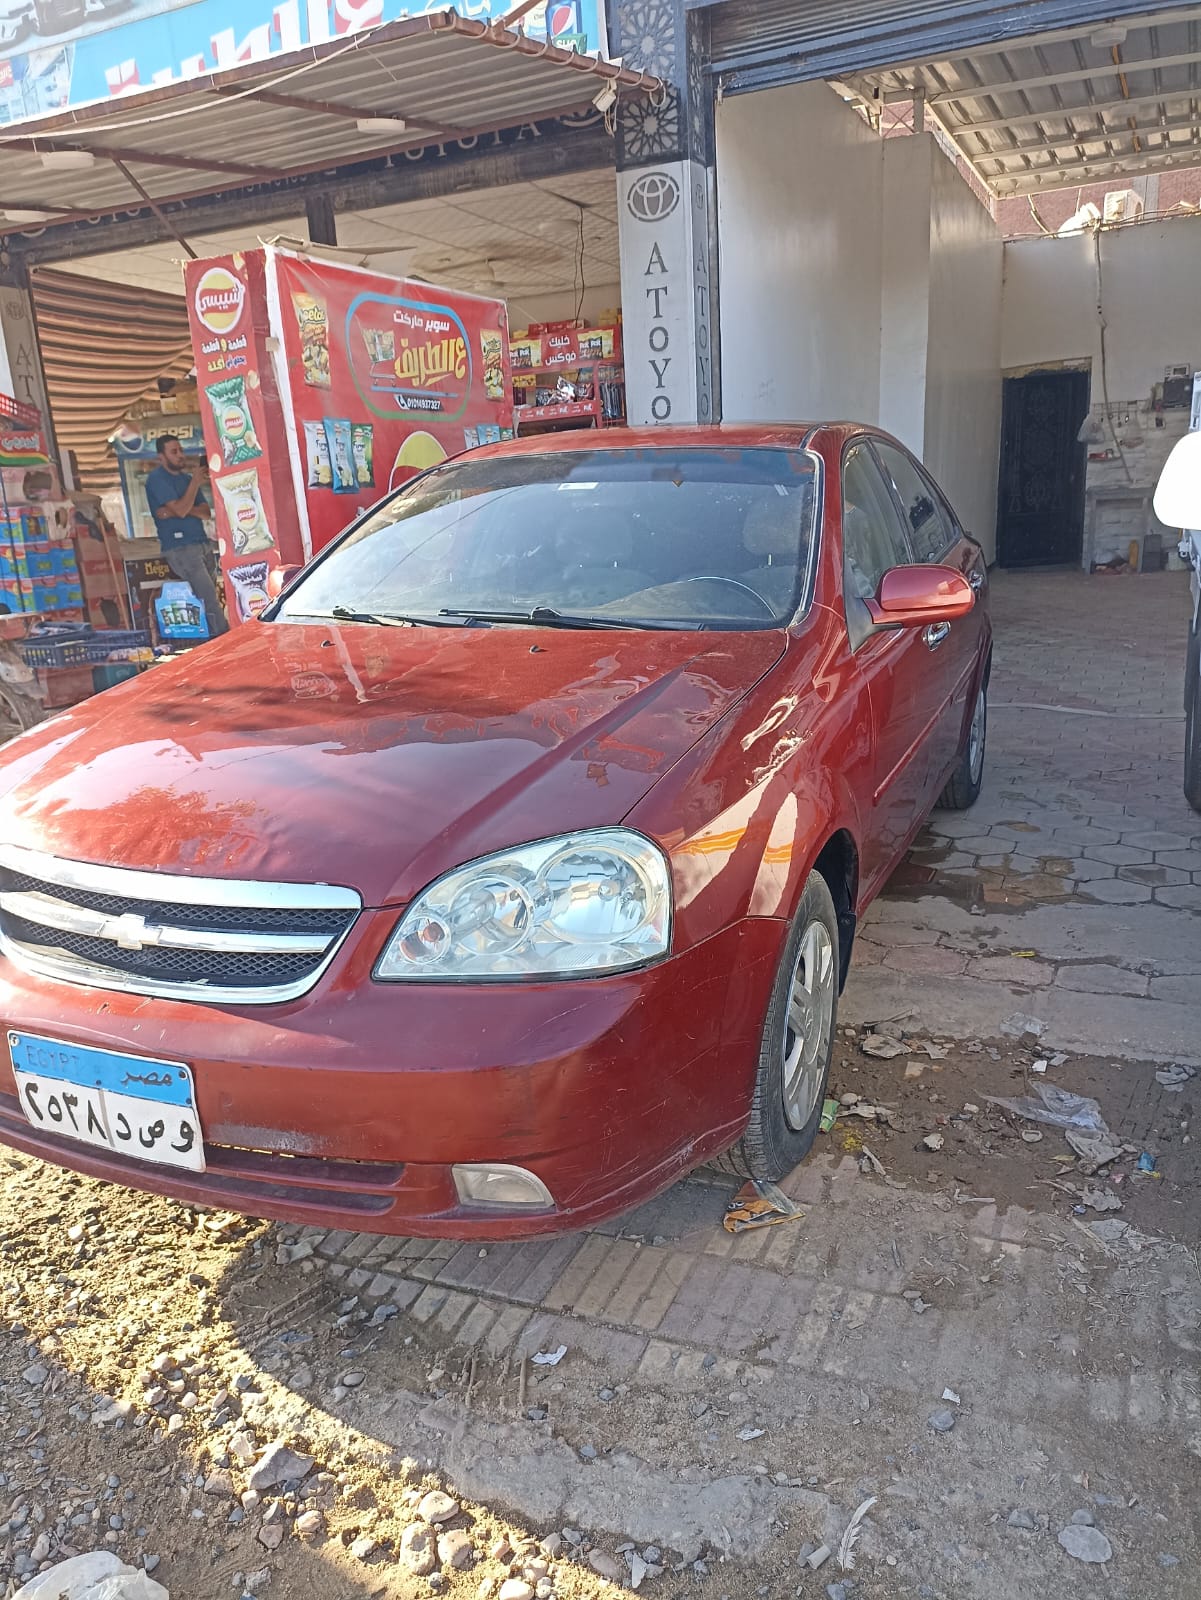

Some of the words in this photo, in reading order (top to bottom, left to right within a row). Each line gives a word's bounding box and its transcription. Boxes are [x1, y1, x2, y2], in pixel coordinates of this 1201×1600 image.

[393, 309, 424, 329] ماركت
[425, 320, 449, 332] سوبر
[549, 335, 570, 349] خليك
[545, 351, 576, 366] فوكس
[120, 1070, 173, 1087] مصر
